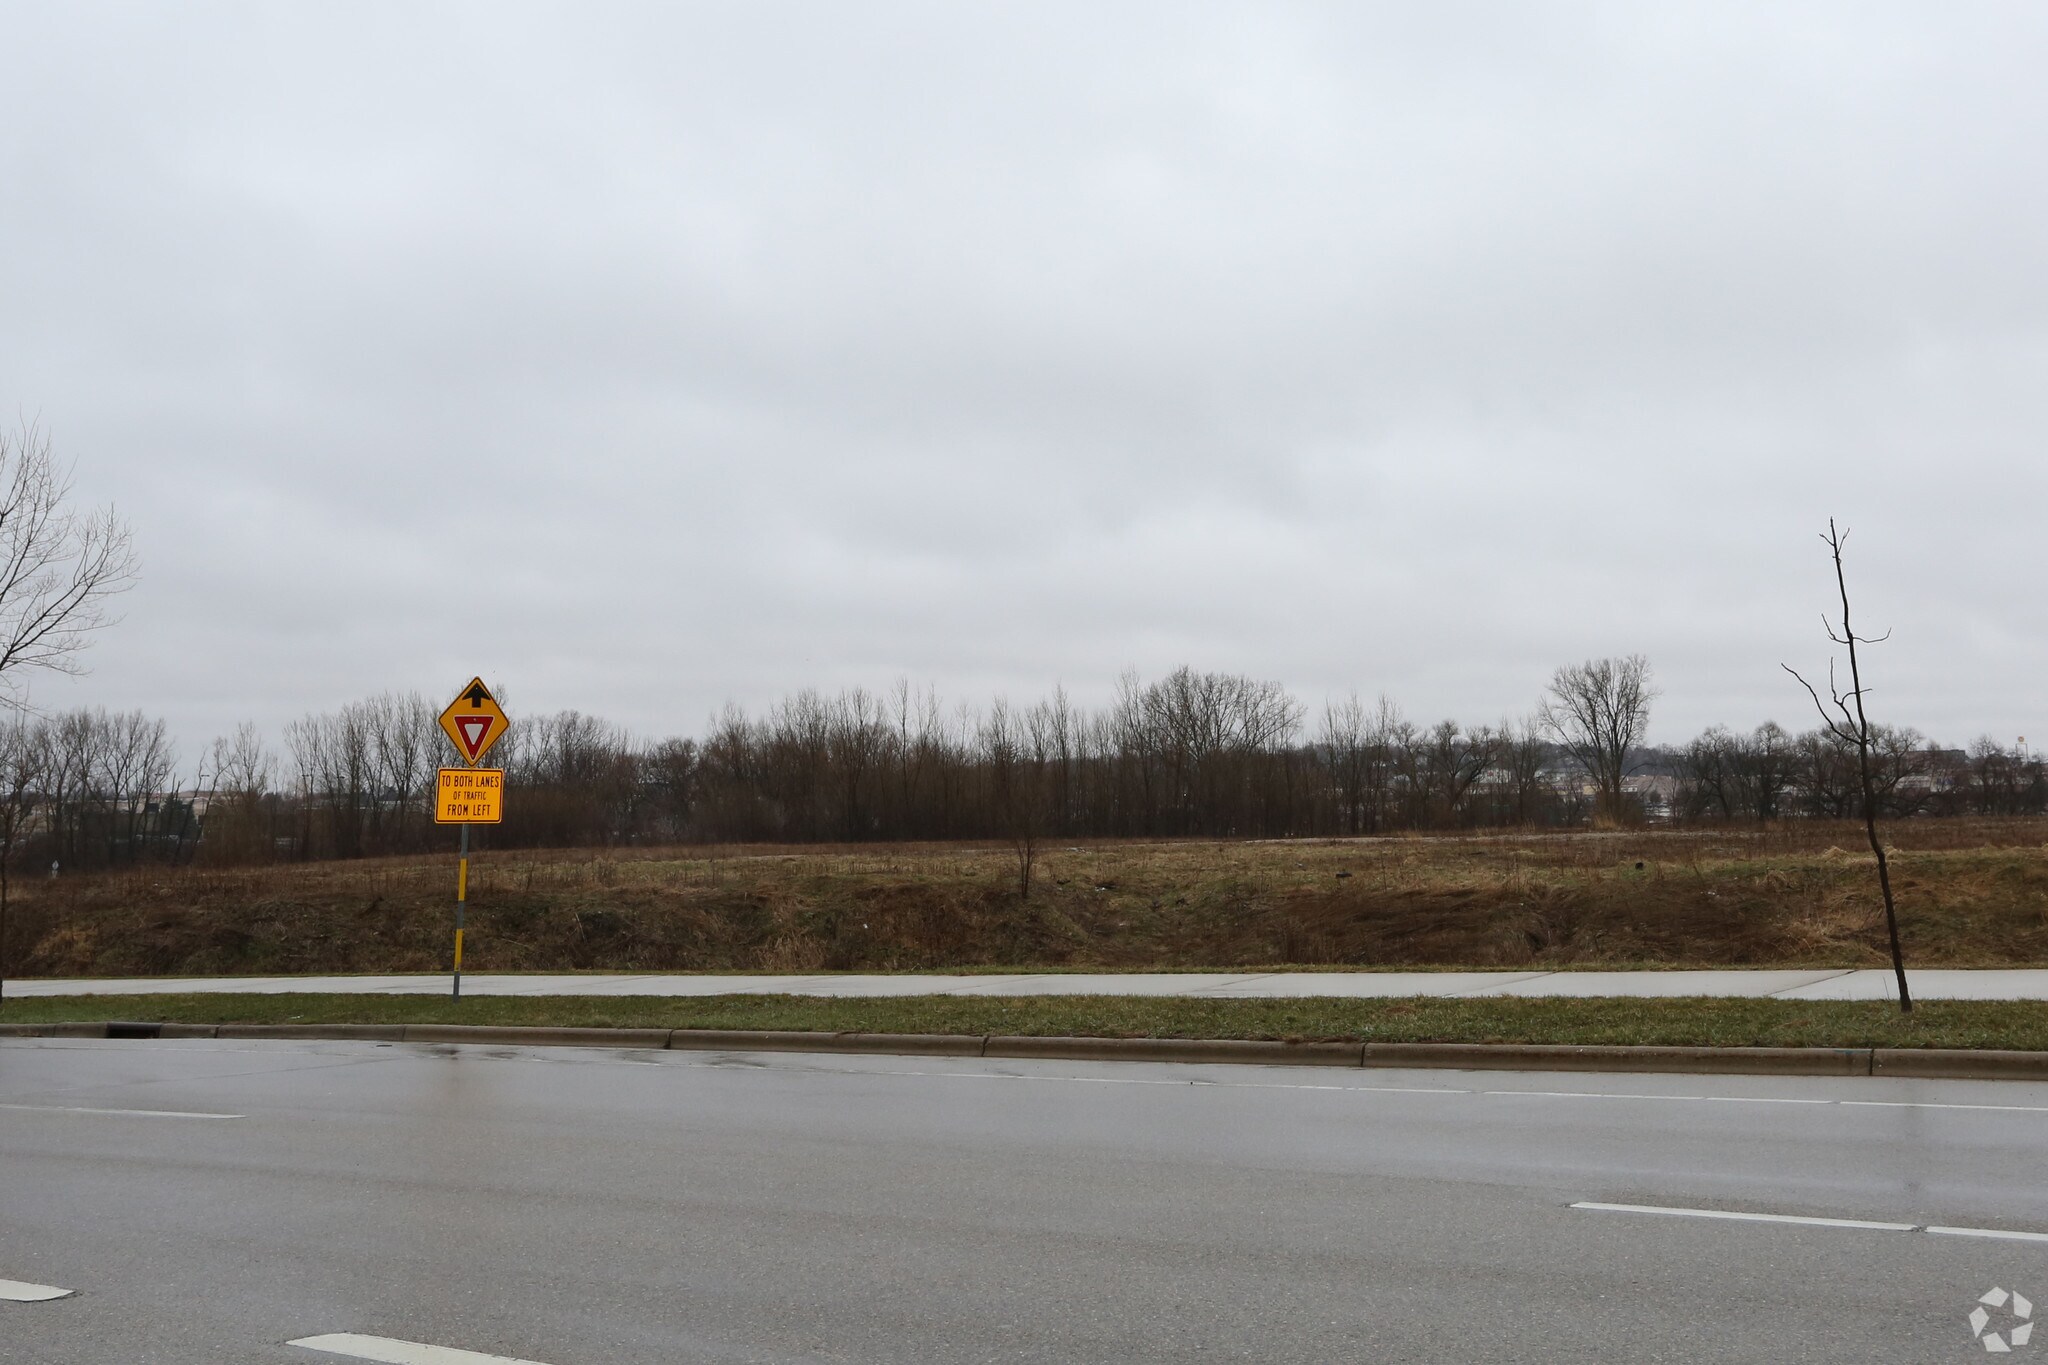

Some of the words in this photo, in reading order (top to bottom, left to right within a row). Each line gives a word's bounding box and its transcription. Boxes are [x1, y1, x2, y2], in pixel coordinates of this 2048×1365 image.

[442, 775, 451, 787] TO
[454, 775, 473, 787] BOTH
[476, 776, 499, 787] LANES
[453, 791, 461, 800] OF
[464, 791, 486, 800] TRAFFIC
[447, 804, 468, 816] FROM
[473, 804, 491, 816] LEFT
